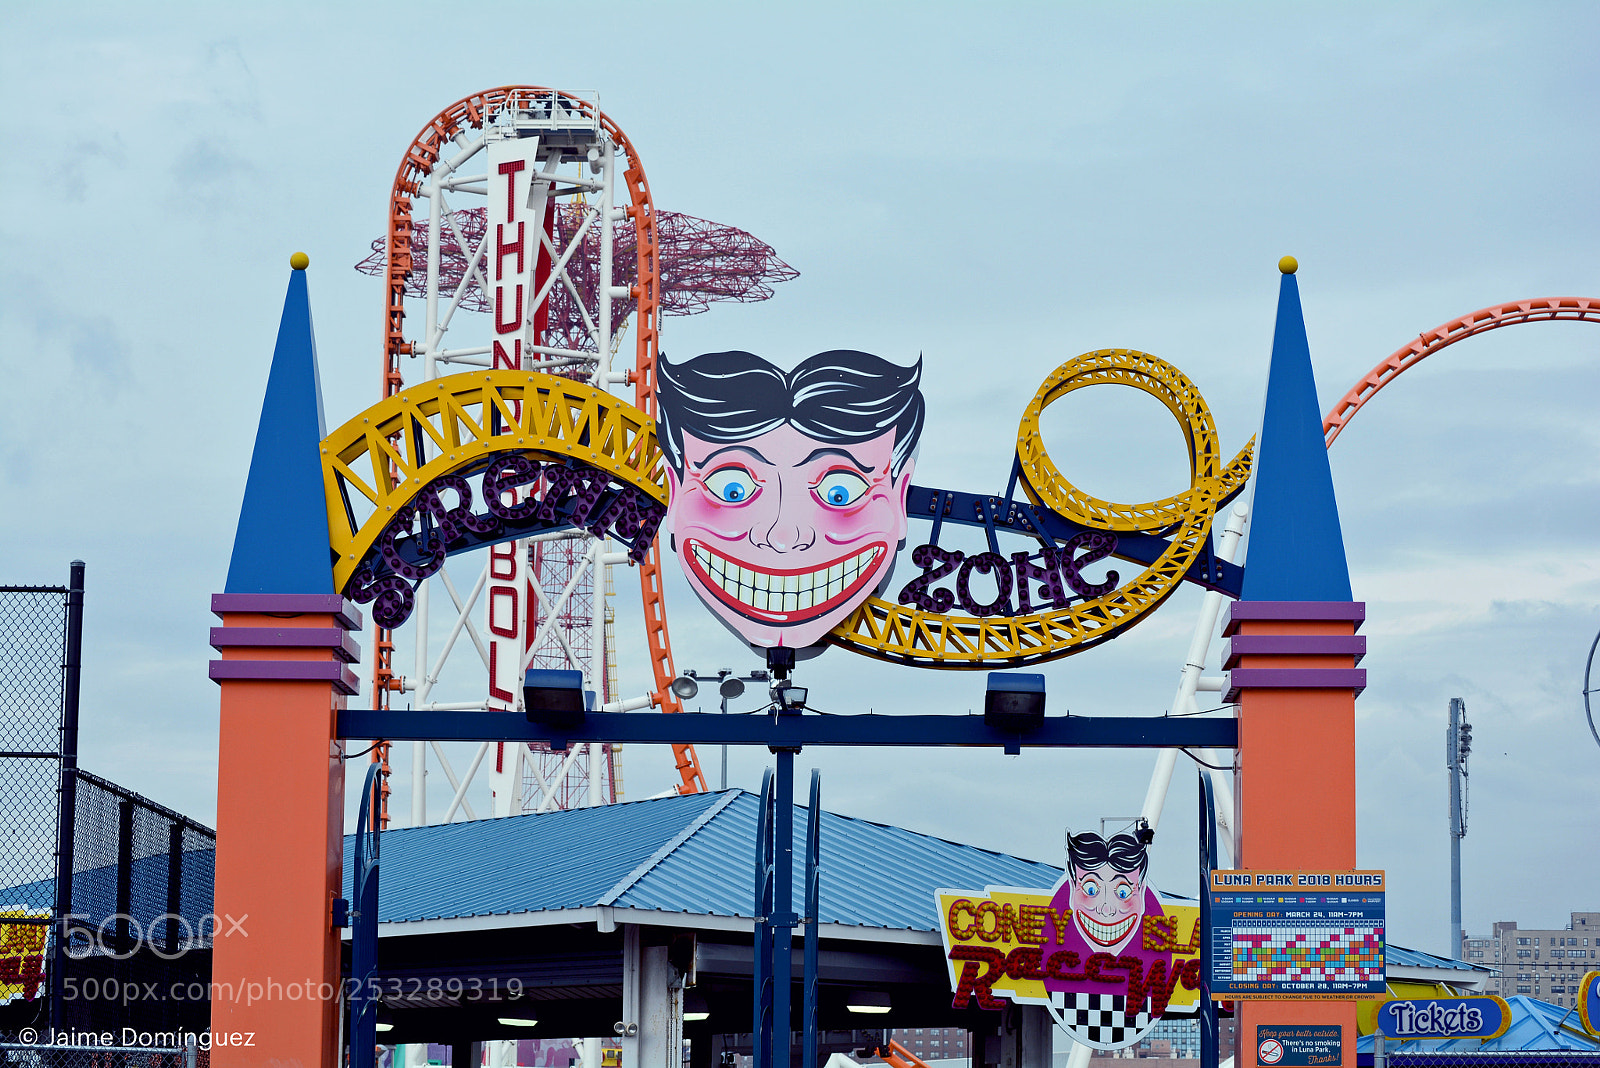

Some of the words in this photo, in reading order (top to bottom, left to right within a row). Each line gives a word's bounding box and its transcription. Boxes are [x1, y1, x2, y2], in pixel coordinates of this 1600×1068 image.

[1214, 874, 1252, 886] LUNA
[1256, 874, 1293, 886] PARK
[1298, 874, 1330, 886] 2018
[1335, 874, 1382, 886] HOURS
[949, 899, 1073, 945] CONEY
[1390, 1000, 1483, 1036] Tickets
[1308, 1053, 1339, 1064] Thanks!
